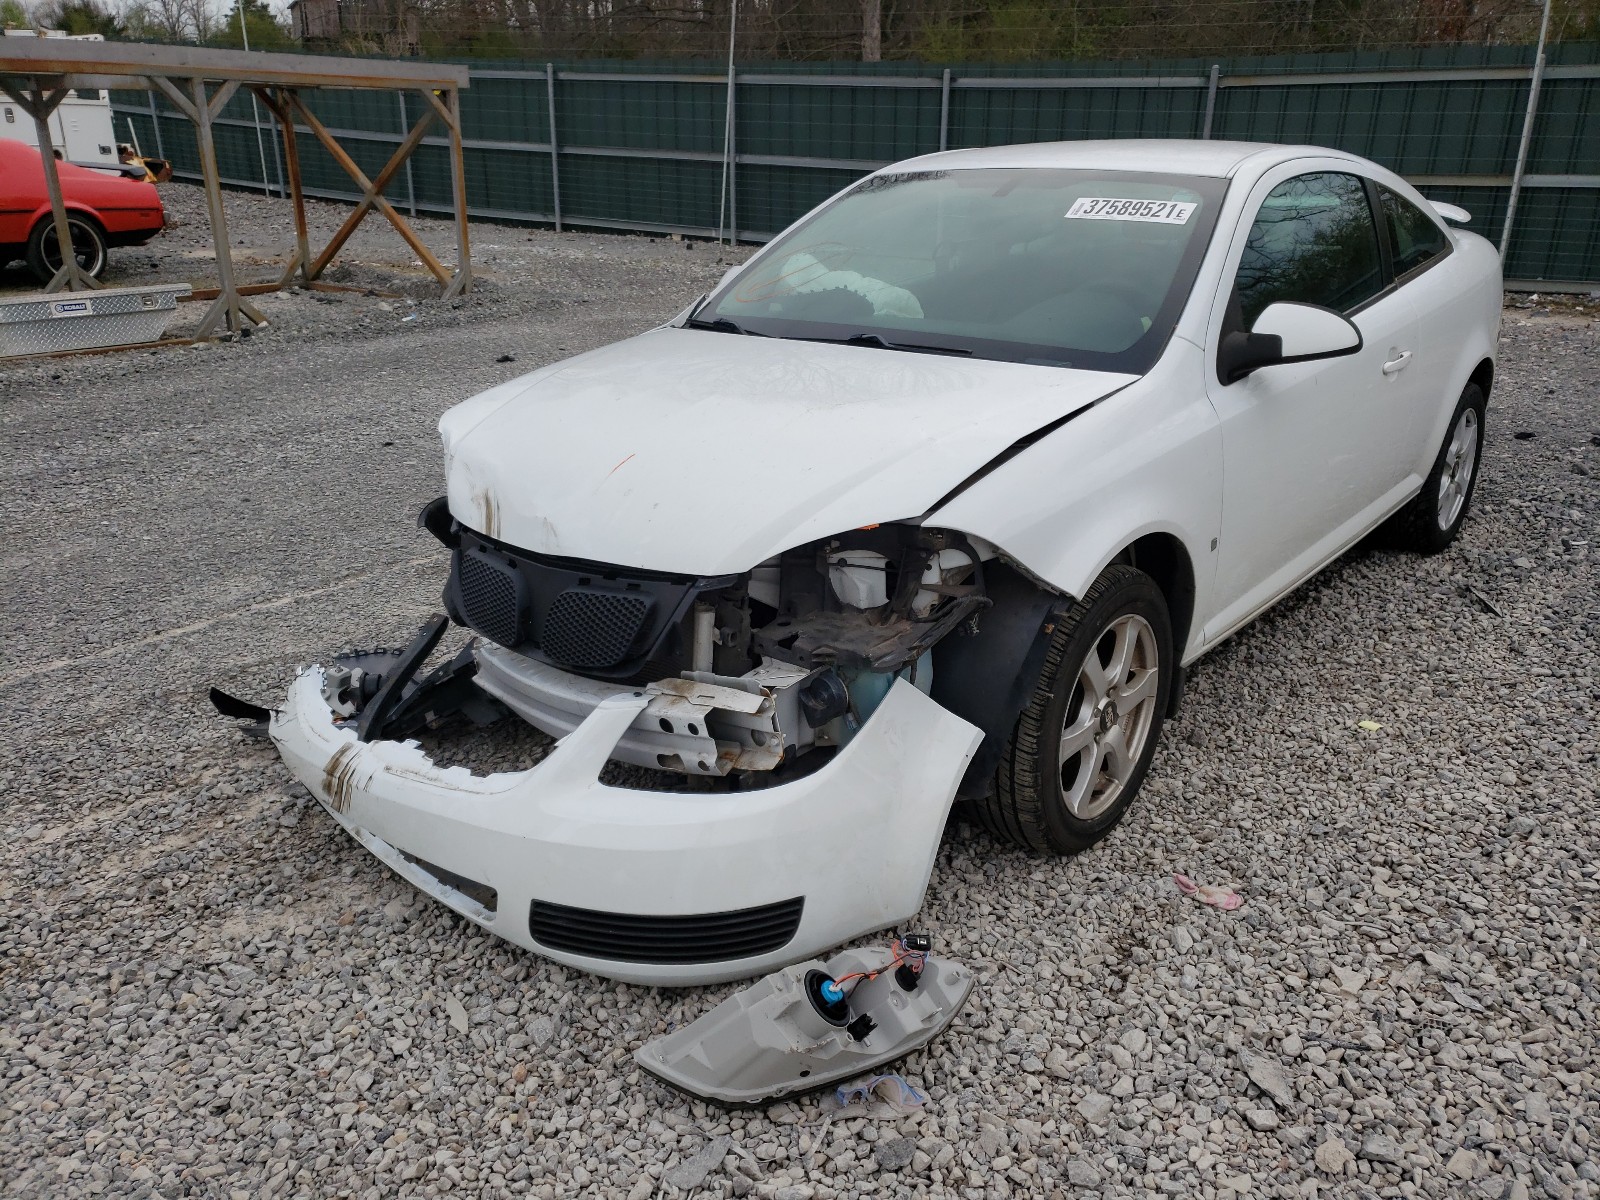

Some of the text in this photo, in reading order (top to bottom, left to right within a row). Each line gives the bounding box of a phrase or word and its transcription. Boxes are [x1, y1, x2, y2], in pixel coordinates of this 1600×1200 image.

[1083, 199, 1178, 219] 37589521
[1175, 208, 1187, 218] E
[63, 303, 87, 311] KOBALT
